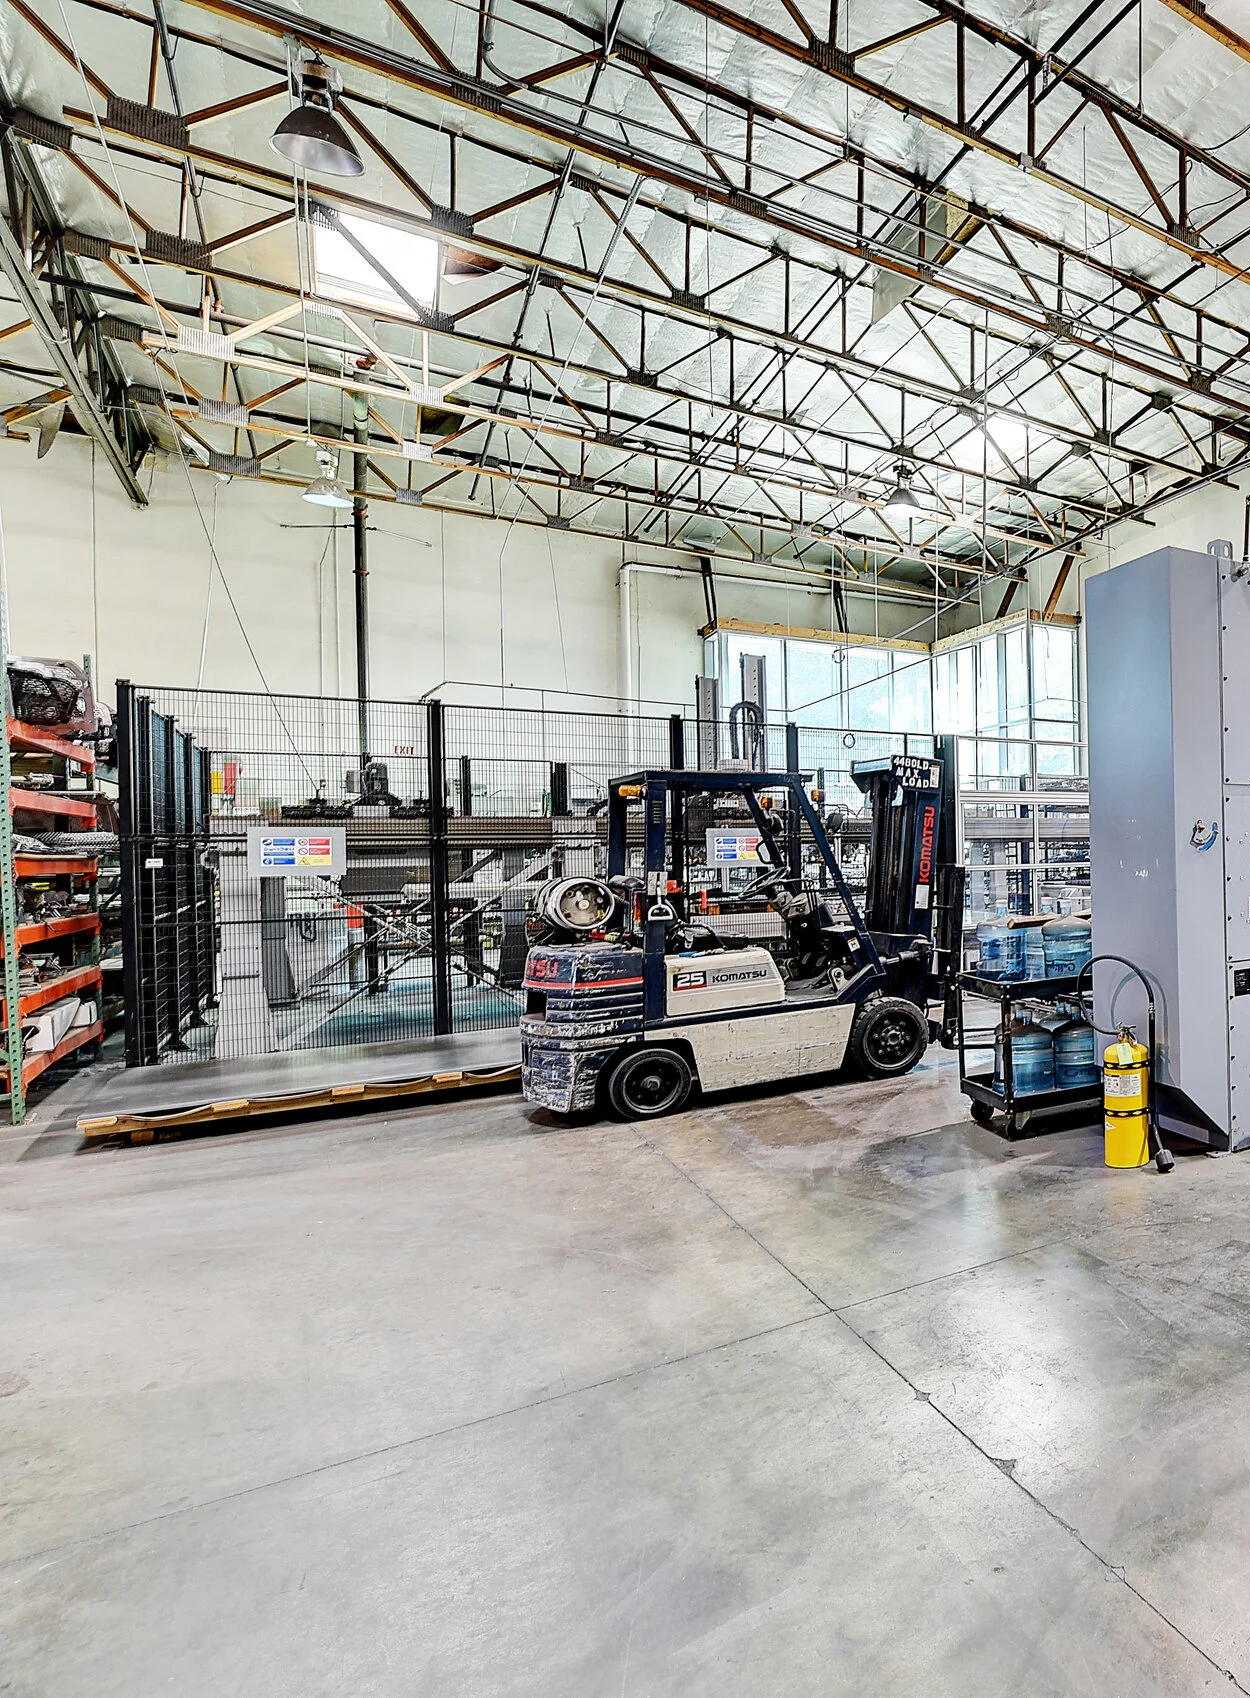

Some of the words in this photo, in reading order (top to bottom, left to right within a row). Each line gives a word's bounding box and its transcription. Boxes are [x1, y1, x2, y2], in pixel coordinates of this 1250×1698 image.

[394, 745, 415, 755] EXIT
[902, 776, 930, 789] LOAD
[918, 805, 936, 883] KOMATSU
[676, 973, 705, 989] 25
[711, 968, 768, 984] KOMATSU
